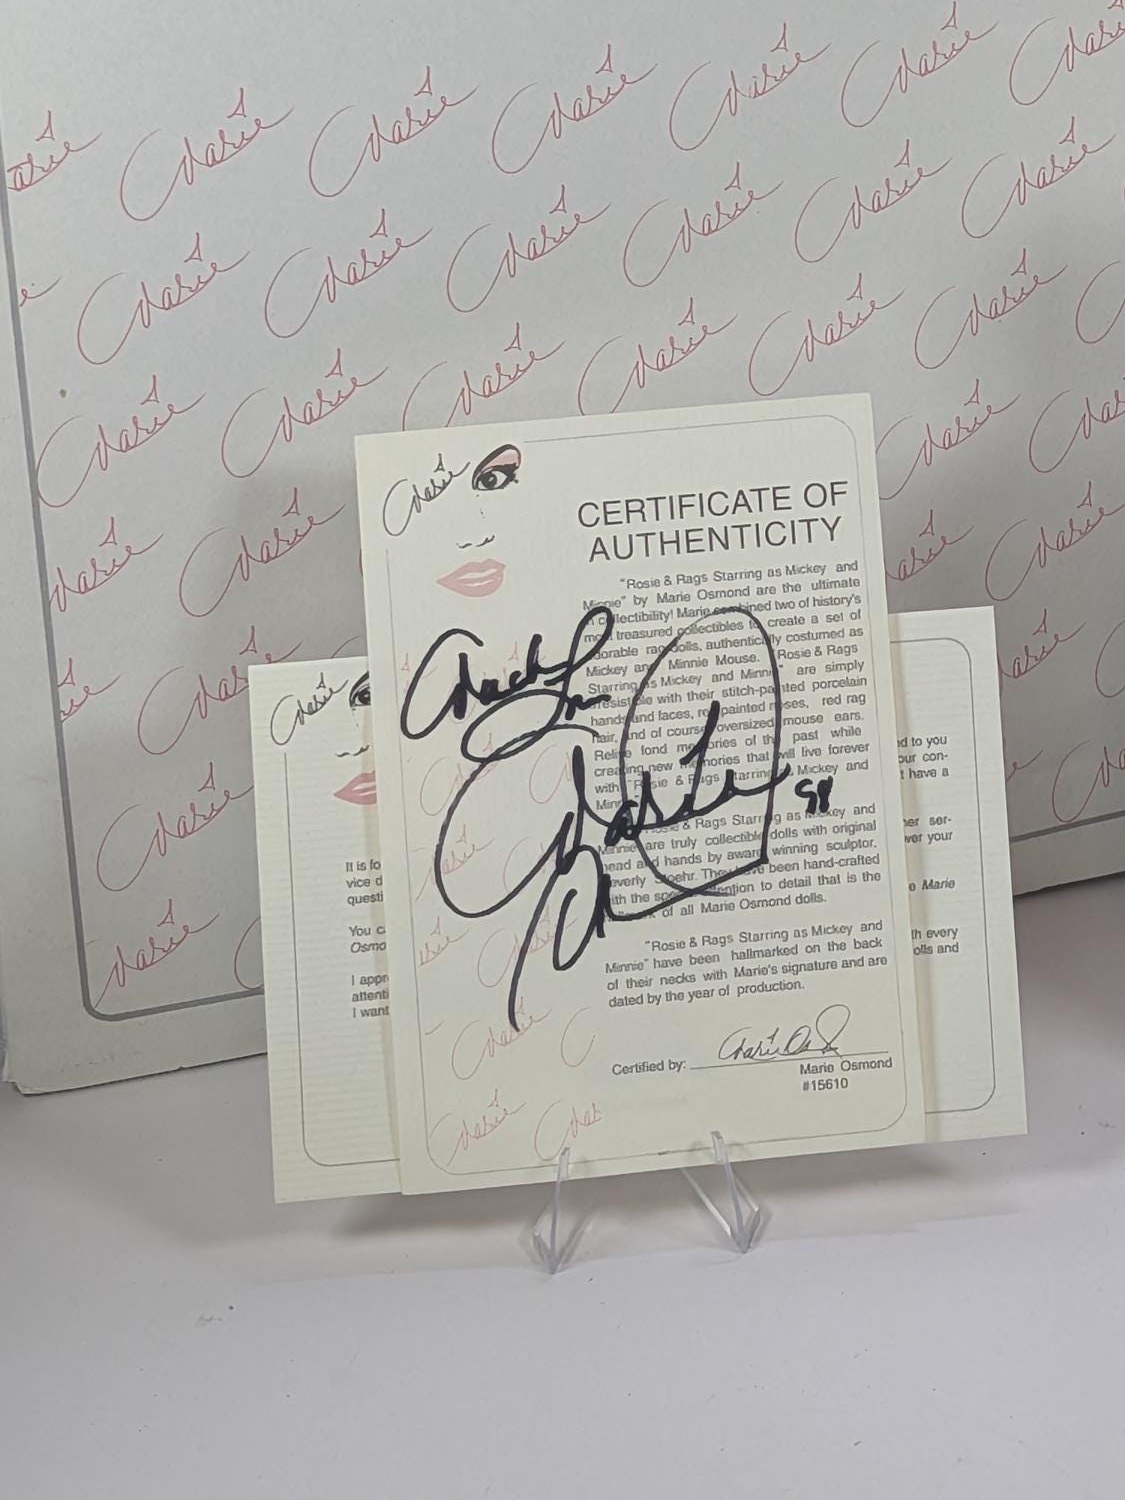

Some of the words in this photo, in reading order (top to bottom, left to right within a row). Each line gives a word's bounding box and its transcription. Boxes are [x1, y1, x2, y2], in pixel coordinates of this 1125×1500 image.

[578, 485, 793, 527] CERTIFICATE
[803, 481, 848, 508] OF
[589, 516, 842, 562] AUTHENTICITY
[620, 577, 661, 590] "Rosie
[664, 575, 672, 586] &
[677, 574, 708, 587] Rags
[713, 568, 762, 582] Starring
[767, 566, 782, 578] as
[785, 563, 826, 577] Mickey
[836, 560, 859, 573] and
[633, 595, 648, 608] by
[656, 591, 691, 605] Marie
[697, 587, 750, 600] Osmond
[756, 583, 777, 596] are
[782, 581, 802, 594] the
[811, 577, 861, 591] ultimate
[774, 601, 795, 612] two
[798, 598, 810, 609] of
[812, 594, 862, 608] history's
[912, 737, 924, 748] to
[928, 735, 948, 751] you
[909, 766, 938, 780] have
[942, 769, 949, 778] a
[772, 843, 818, 856] winning
[826, 839, 877, 852] sculptor.
[769, 861, 799, 873] been
[803, 854, 880, 869] hand-crafted
[761, 880, 772, 891] to
[778, 876, 812, 889] detail
[817, 875, 841, 886] that
[846, 873, 857, 883] is
[862, 871, 881, 882] the
[701, 901, 736, 913] Marie
[739, 896, 792, 910] Osmond
[795, 893, 827, 905] dolls.
[645, 940, 686, 952] "Rosie
[689, 938, 697, 948] &
[702, 935, 734, 948] Rags
[739, 930, 788, 944] Starring
[794, 927, 808, 938] as
[811, 923, 852, 938] Mickey
[860, 920, 883, 932] and
[605, 959, 648, 974] Minnie"
[653, 956, 683, 968] have
[689, 952, 720, 965] been
[731, 944, 798, 960] hallmarked
[805, 944, 821, 954] on
[828, 940, 847, 952] the
[854, 937, 883, 949] back
[607, 979, 619, 990] of
[626, 976, 653, 989] their
[660, 973, 696, 986] necks
[703, 969, 728, 982] with
[734, 963, 778, 978] Marie's
[781, 959, 837, 974] signature
[841, 957, 864, 968] and
[868, 955, 888, 966] are
[609, 996, 644, 1008] dated
[647, 993, 661, 1006] by
[665, 990, 685, 1001] the
[688, 988, 715, 1001] year
[719, 984, 730, 996] of
[737, 980, 804, 997] production.
[612, 1061, 664, 1075] Certified
[669, 1060, 687, 1072] by:
[800, 1062, 834, 1075] Marie
[840, 1058, 892, 1071] Osmond
[803, 1077, 848, 1091] #15610
